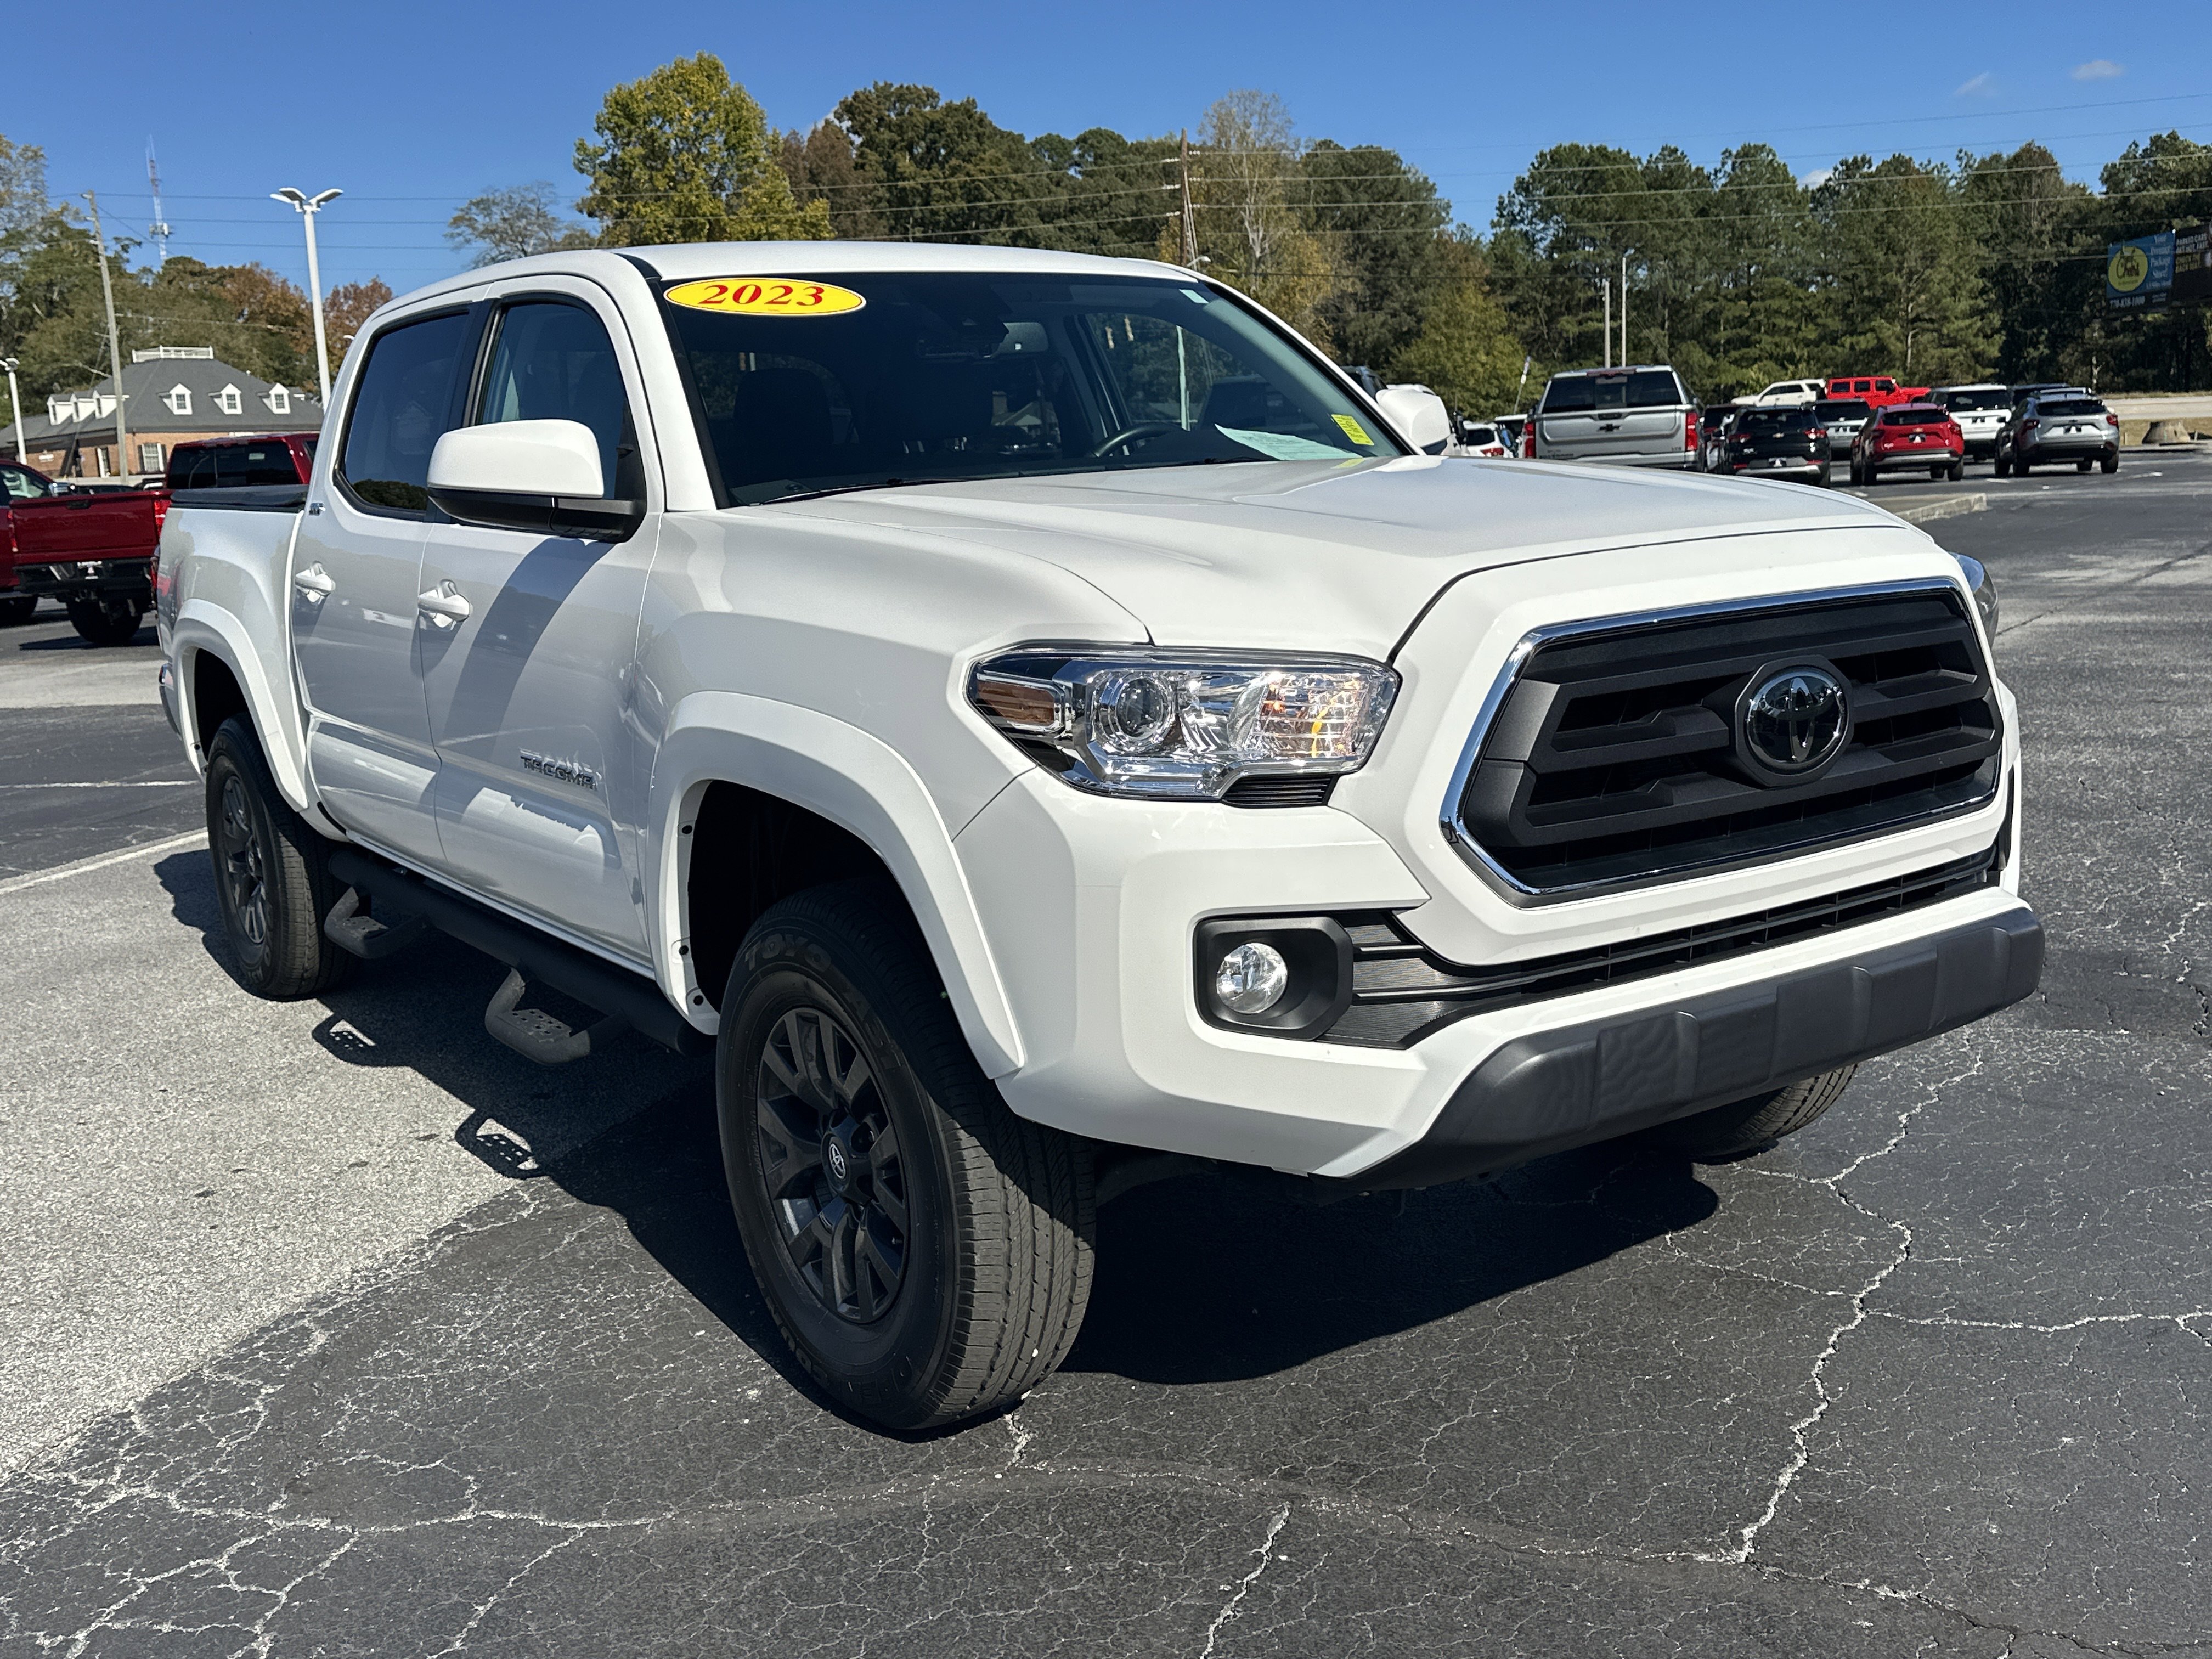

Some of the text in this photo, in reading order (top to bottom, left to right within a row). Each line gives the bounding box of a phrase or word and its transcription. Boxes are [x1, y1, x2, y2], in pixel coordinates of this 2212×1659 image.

[698, 284, 825, 306] 2023
[520, 751, 602, 791] TACOMA
[744, 933, 832, 972] TOYO
